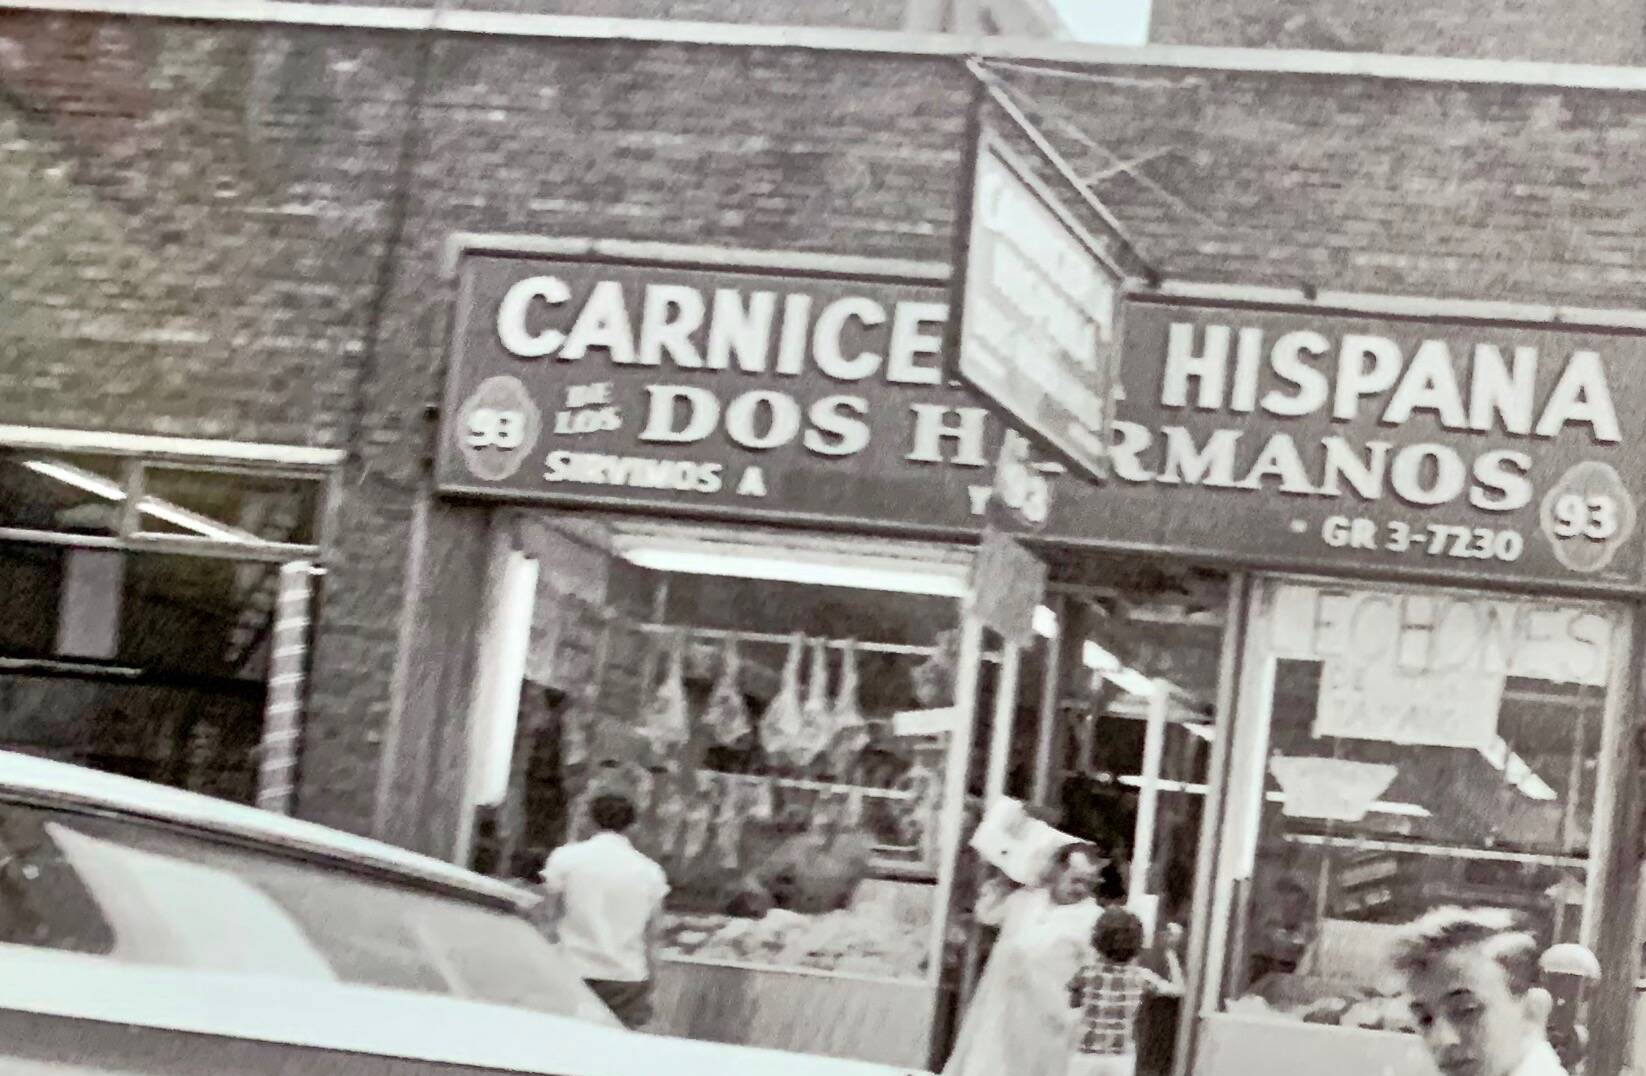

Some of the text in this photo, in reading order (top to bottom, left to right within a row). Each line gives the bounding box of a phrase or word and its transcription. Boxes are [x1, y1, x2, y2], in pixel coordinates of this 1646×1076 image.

[498, 276, 966, 386] CARNICE
[1160, 321, 1622, 443] HISPANA
[466, 408, 526, 450] 93
[638, 384, 871, 456] DOS
[902, 402, 1535, 512] HRMANOS
[1321, 514, 1523, 562] GR 3-7230
[1551, 494, 1617, 539] 93
